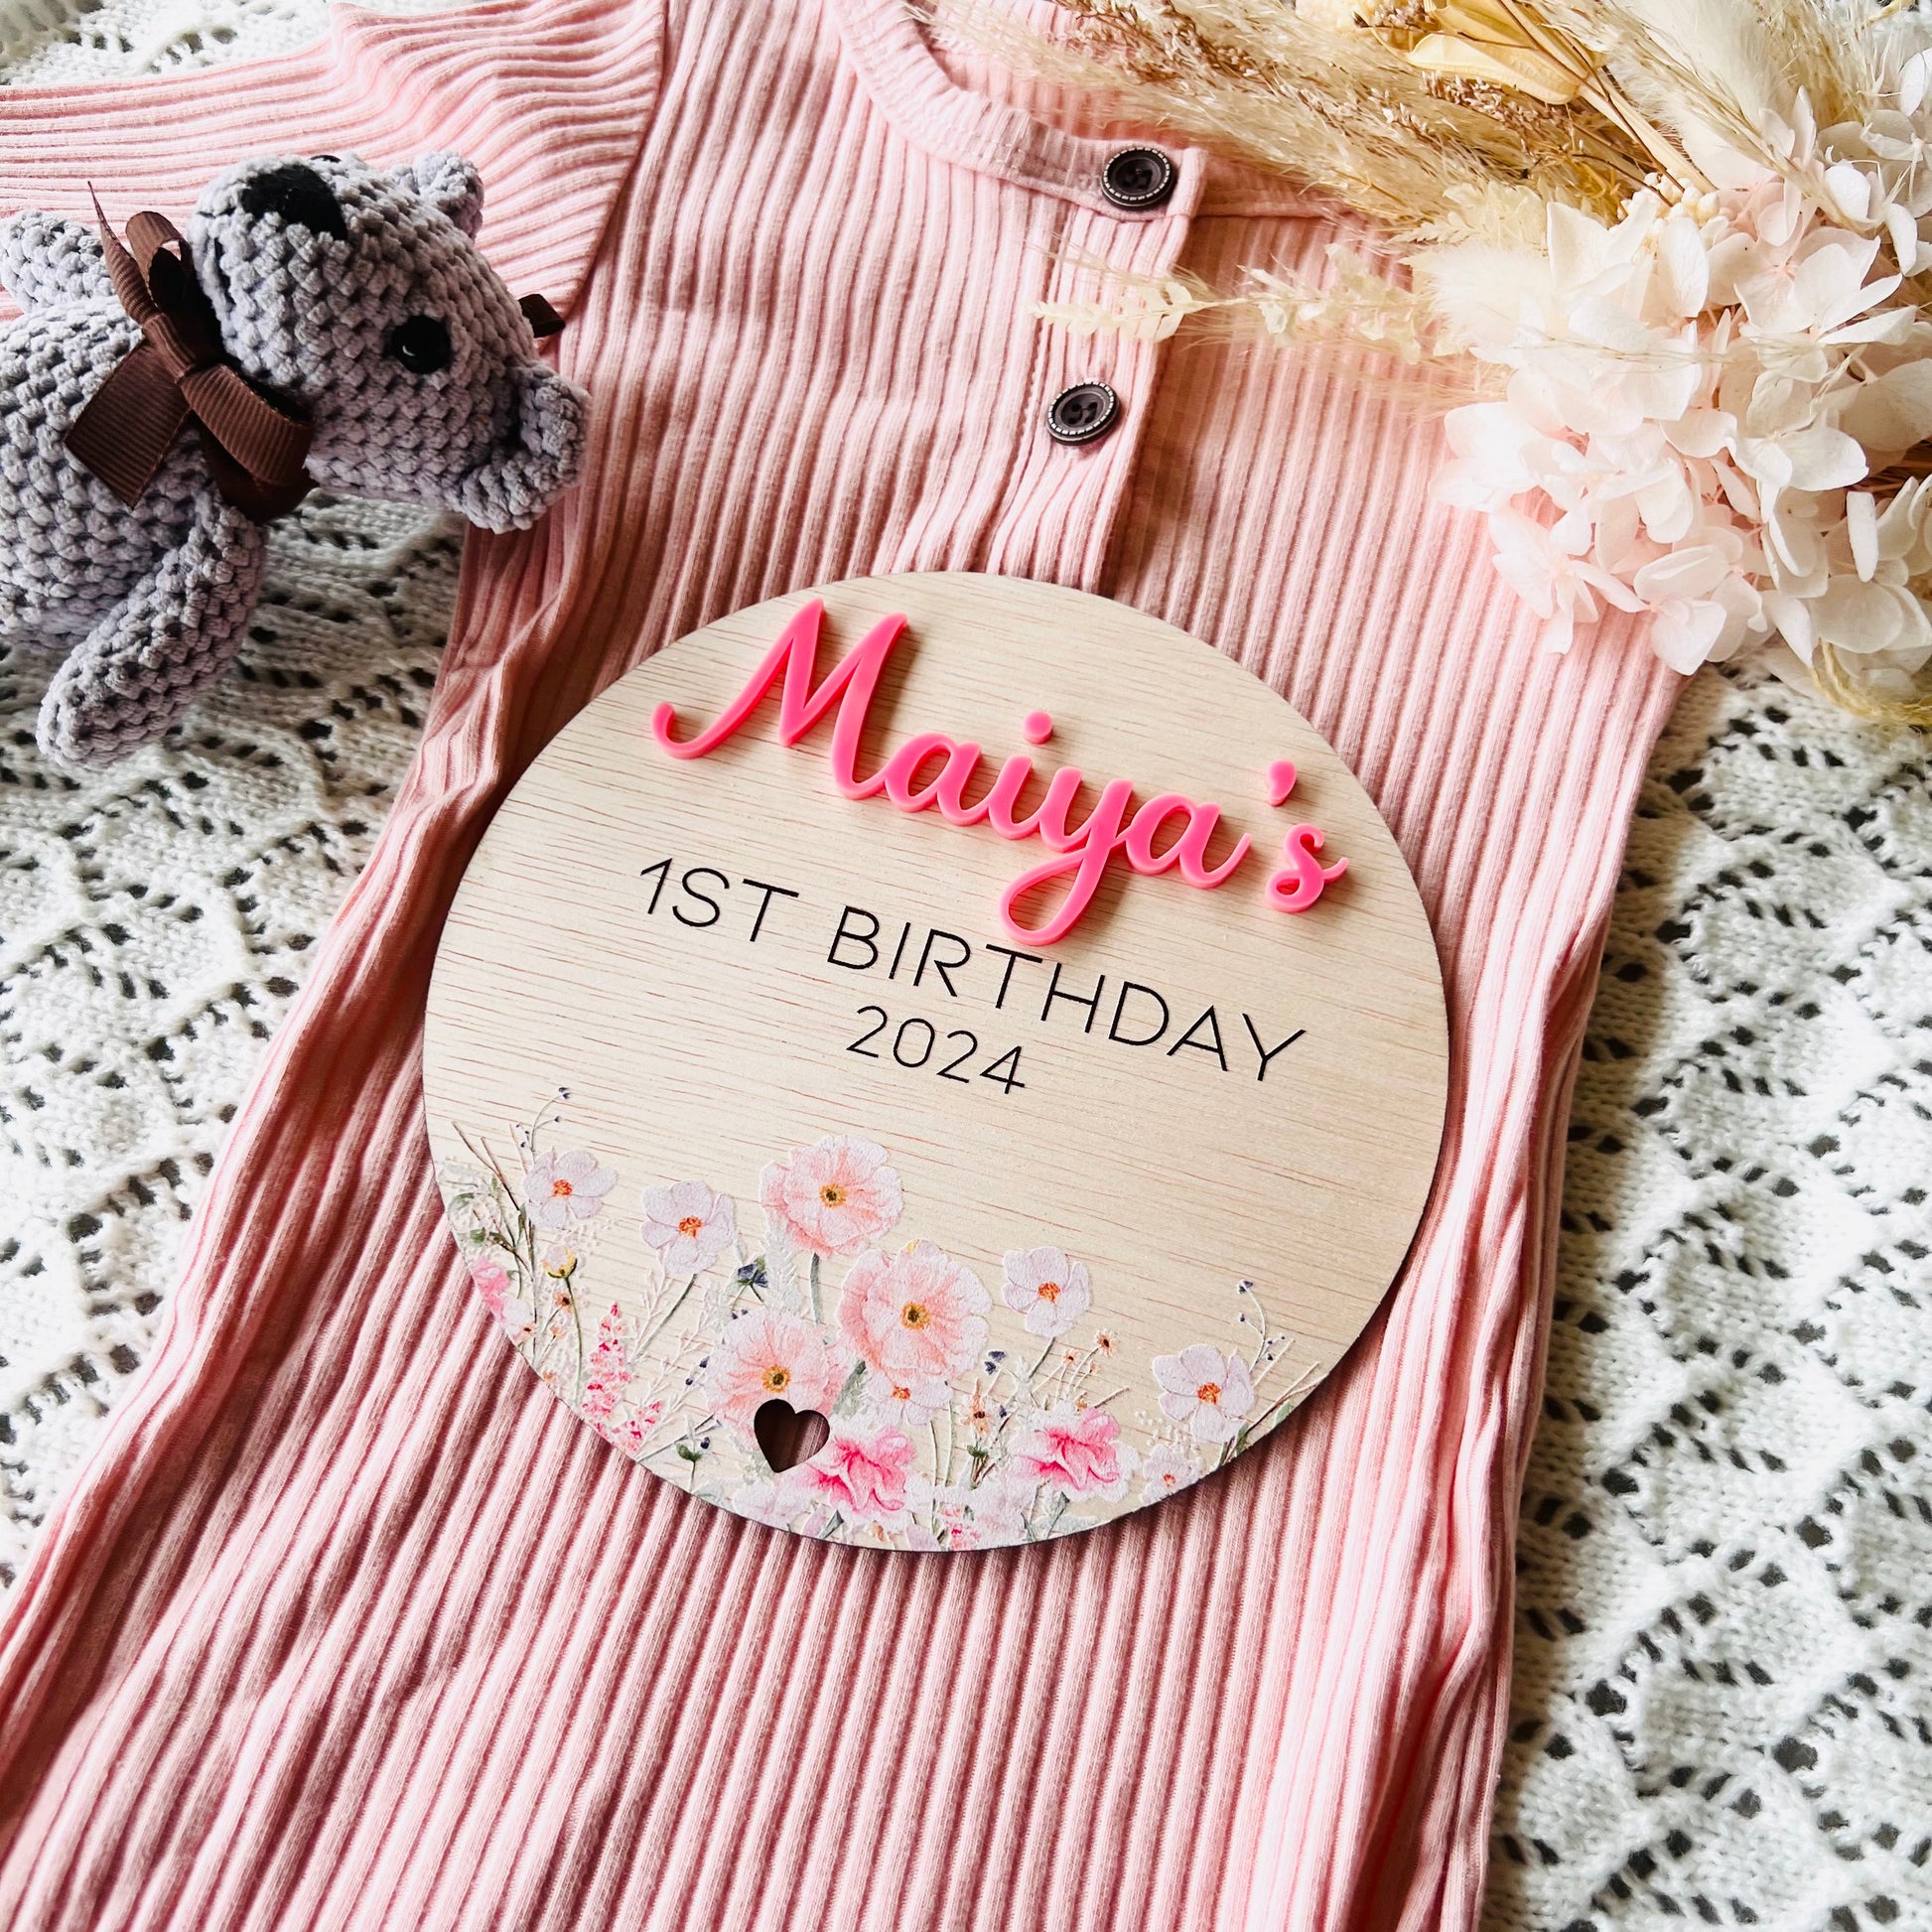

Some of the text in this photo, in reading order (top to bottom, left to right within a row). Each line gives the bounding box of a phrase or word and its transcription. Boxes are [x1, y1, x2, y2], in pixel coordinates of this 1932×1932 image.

[651, 598, 1348, 946] Maiya's
[639, 858, 1307, 1082] 1ST BIRTHDAY
[847, 1006, 1026, 1095] 2024
